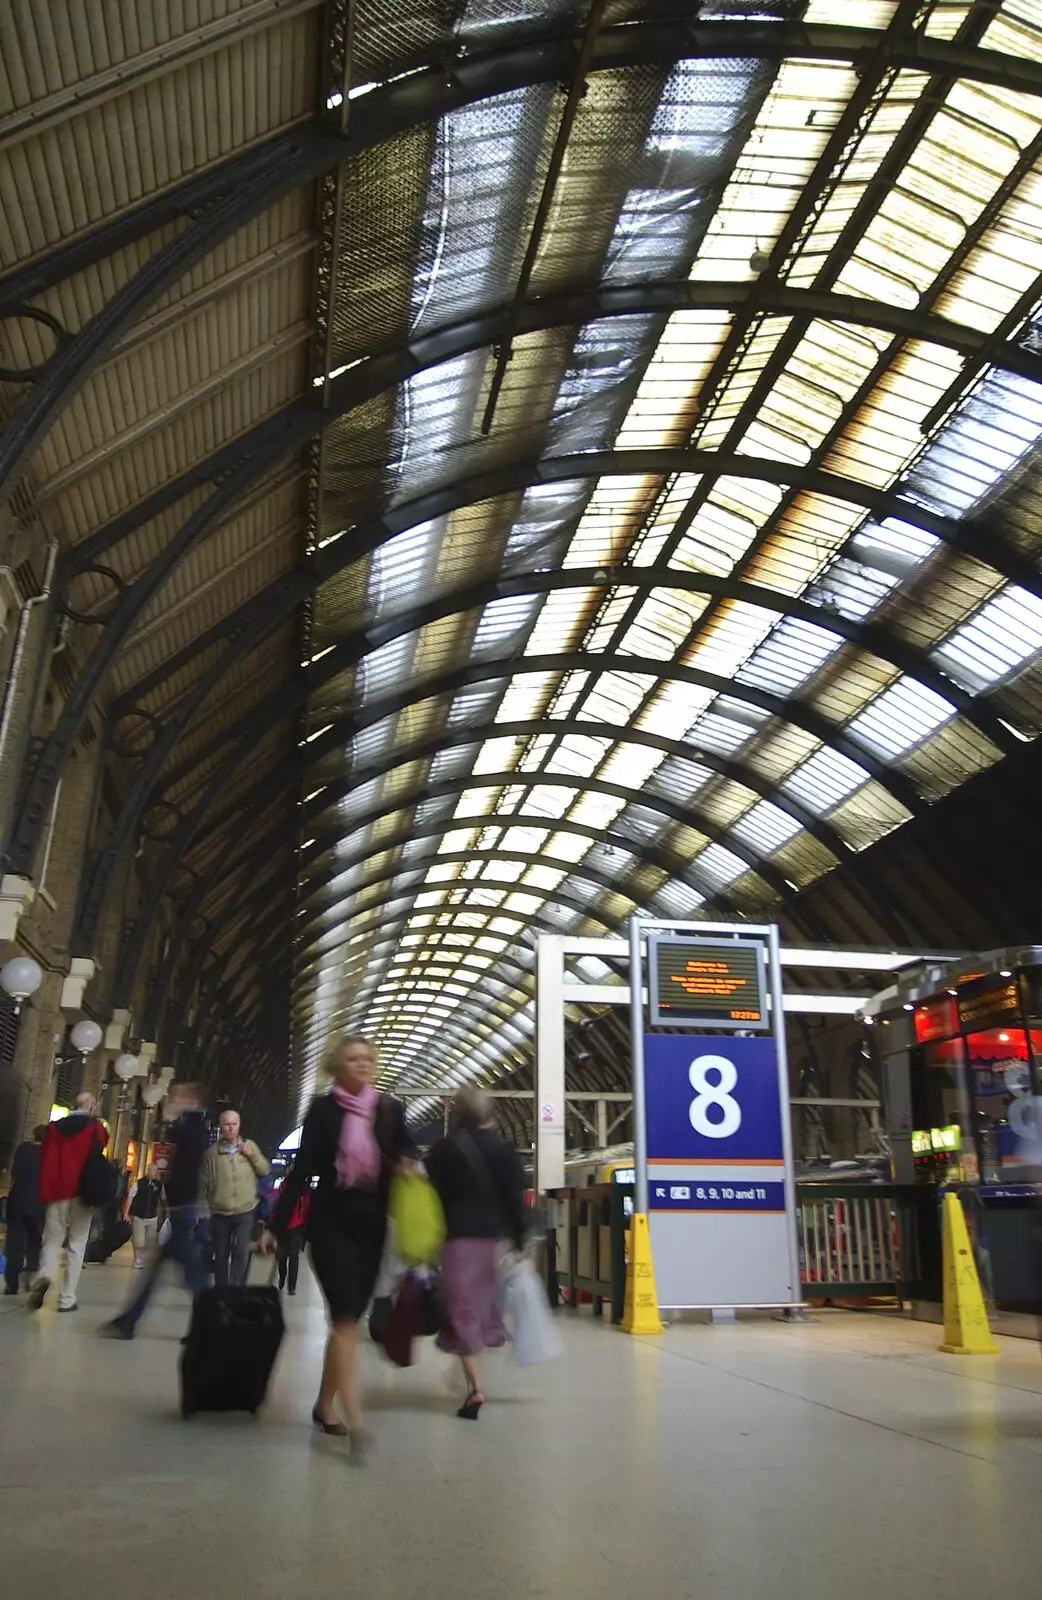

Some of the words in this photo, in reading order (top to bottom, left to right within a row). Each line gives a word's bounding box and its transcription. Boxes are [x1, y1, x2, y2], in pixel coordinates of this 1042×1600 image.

[688, 1054, 742, 1139] 8
[696, 1187, 707, 1200] 8,
[709, 1187, 720, 1200] 9,
[721, 1187, 734, 1199] 10
[735, 1188, 754, 1200] and
[756, 1188, 766, 1200] 11
